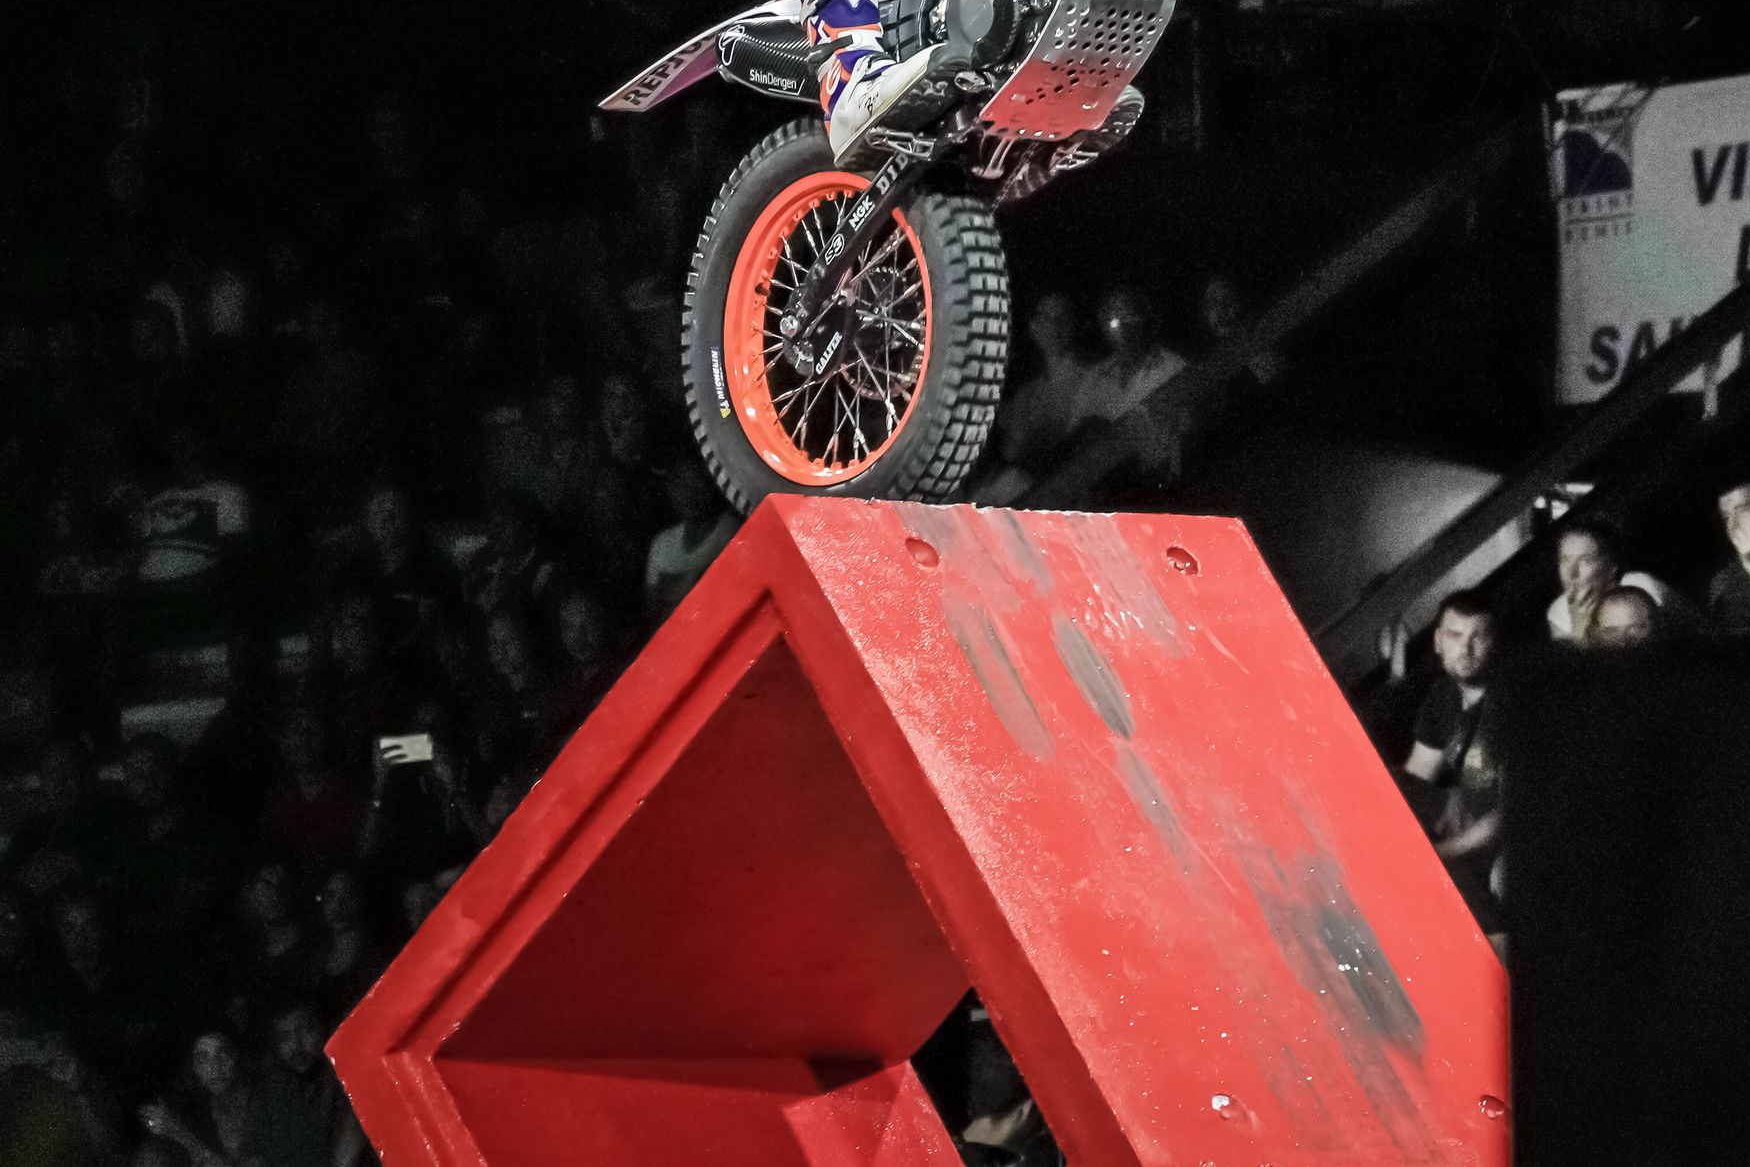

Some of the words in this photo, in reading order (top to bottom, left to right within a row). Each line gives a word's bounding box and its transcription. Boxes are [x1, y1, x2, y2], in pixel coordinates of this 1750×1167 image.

[749, 70, 797, 90] ShinDengen
[849, 195, 873, 229] NGK
[825, 234, 845, 265] S3
